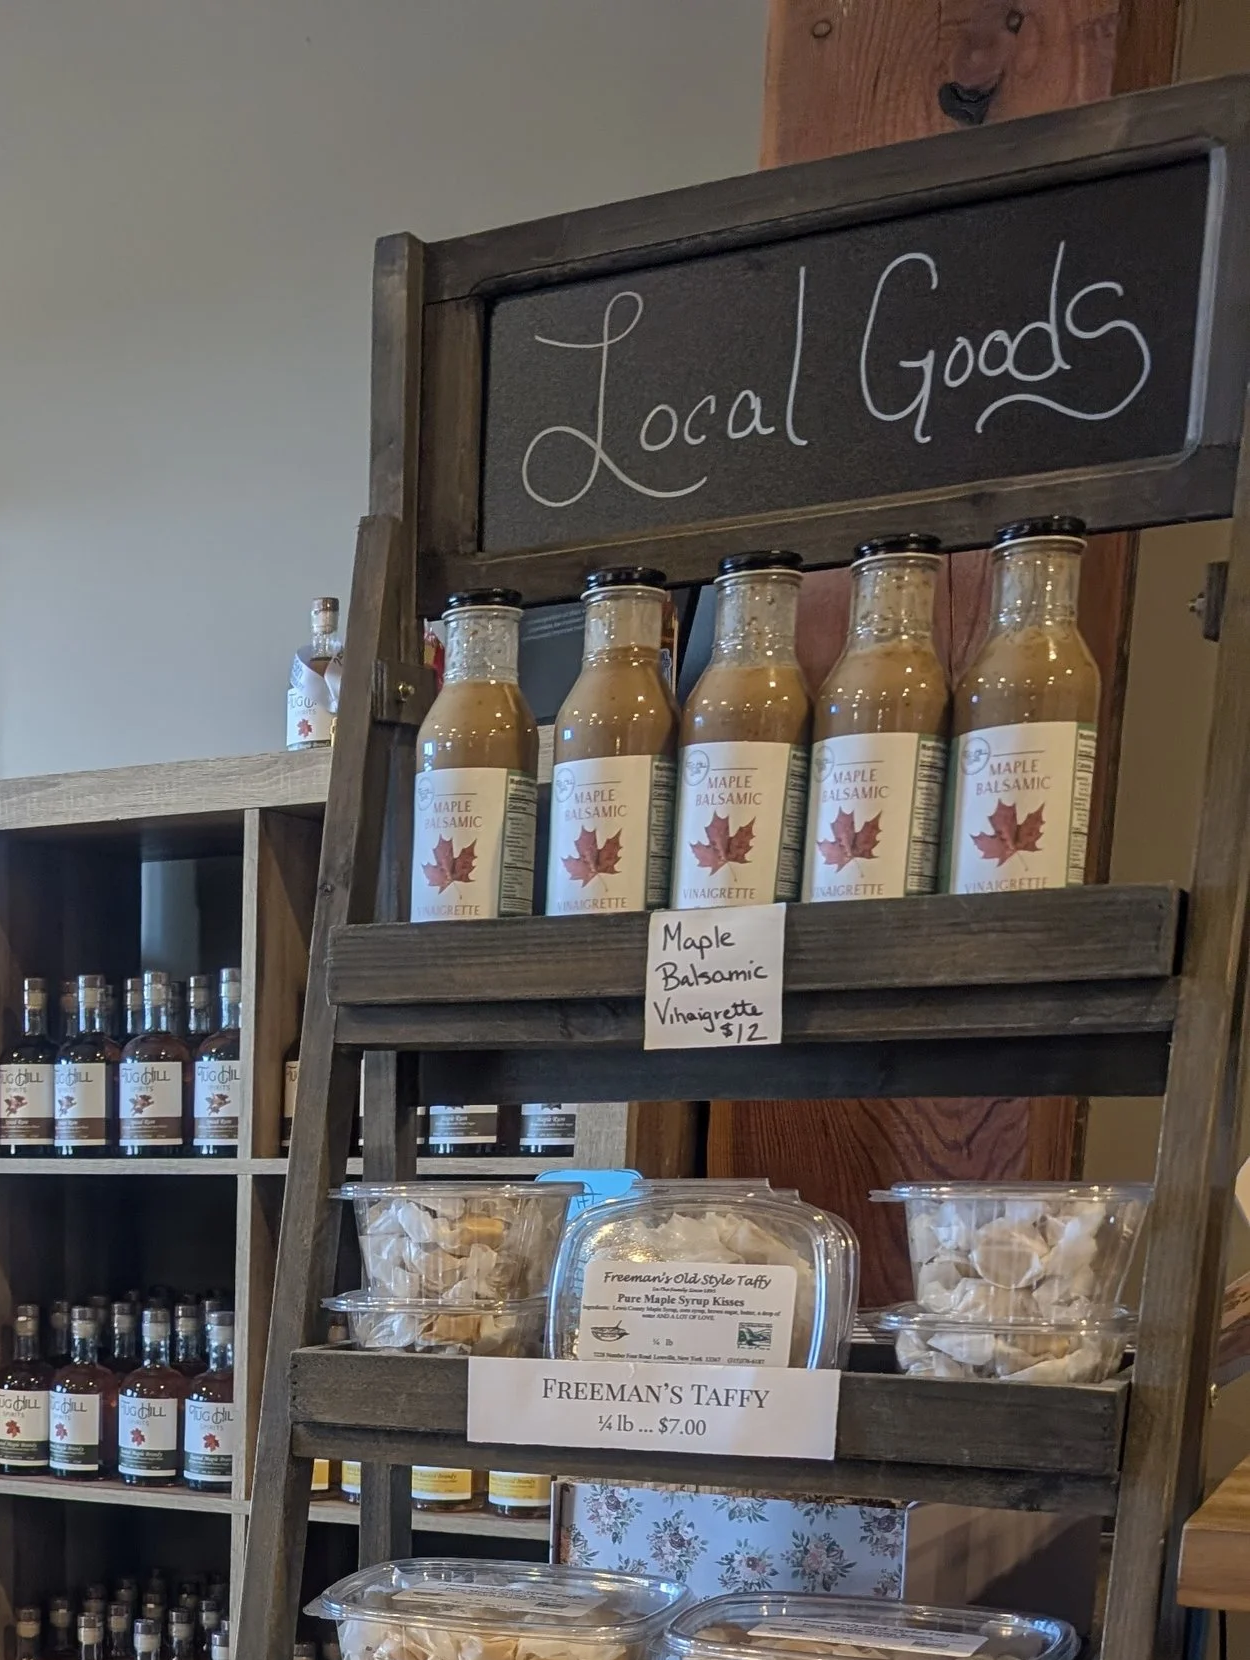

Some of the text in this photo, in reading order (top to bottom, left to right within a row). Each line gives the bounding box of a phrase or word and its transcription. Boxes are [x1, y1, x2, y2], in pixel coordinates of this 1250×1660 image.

[523, 241, 1152, 507] Local Goods
[989, 759, 1039, 775] MAPLE
[708, 776, 753, 790] MAPLE
[832, 769, 878, 784] MAPLE
[822, 786, 889, 802] BALSAMIC
[976, 776, 1051, 796] BALSAMIC
[574, 790, 615, 803] MAPLE
[695, 793, 762, 807] BALSAMIC
[433, 801, 471, 814] MAPLE
[565, 805, 627, 819] BALSAMIC
[424, 816, 483, 829] BALSAMIC
[683, 888, 755, 901] VINAIGRETTE
[662, 921, 735, 960] Maple
[655, 960, 768, 991] Balsamic
[654, 997, 763, 1033] Vinaigrette
[720, 1022, 768, 1044] $12
[603, 1272, 771, 1289] Freeman's Old Style Taffy
[618, 1294, 745, 1307] Pure Maple Syrup Kisses
[617, 1414, 634, 1433] lb
[658, 1418, 706, 1436] $7.00
